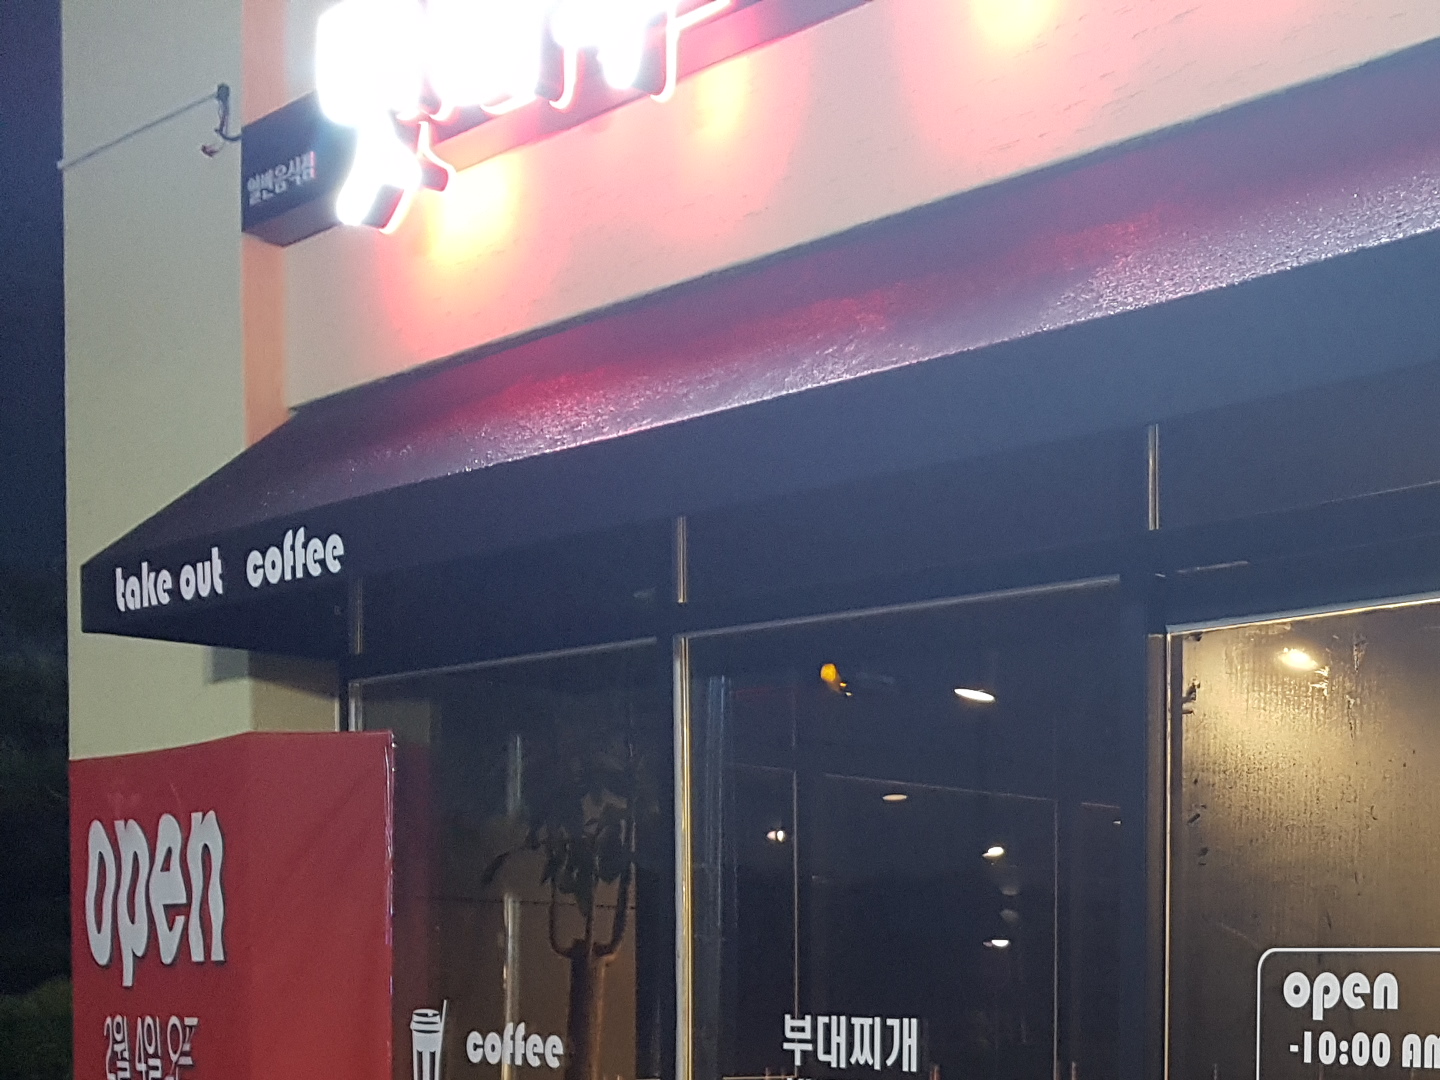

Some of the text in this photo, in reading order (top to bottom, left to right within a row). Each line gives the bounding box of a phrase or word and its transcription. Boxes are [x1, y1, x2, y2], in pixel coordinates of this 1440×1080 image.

[115, 526, 345, 612] take out coffee
[85, 810, 225, 987] open
[1283, 971, 1399, 1021] open
[466, 1022, 564, 1070] coffee
[782, 1014, 918, 1073] 부대찌개
